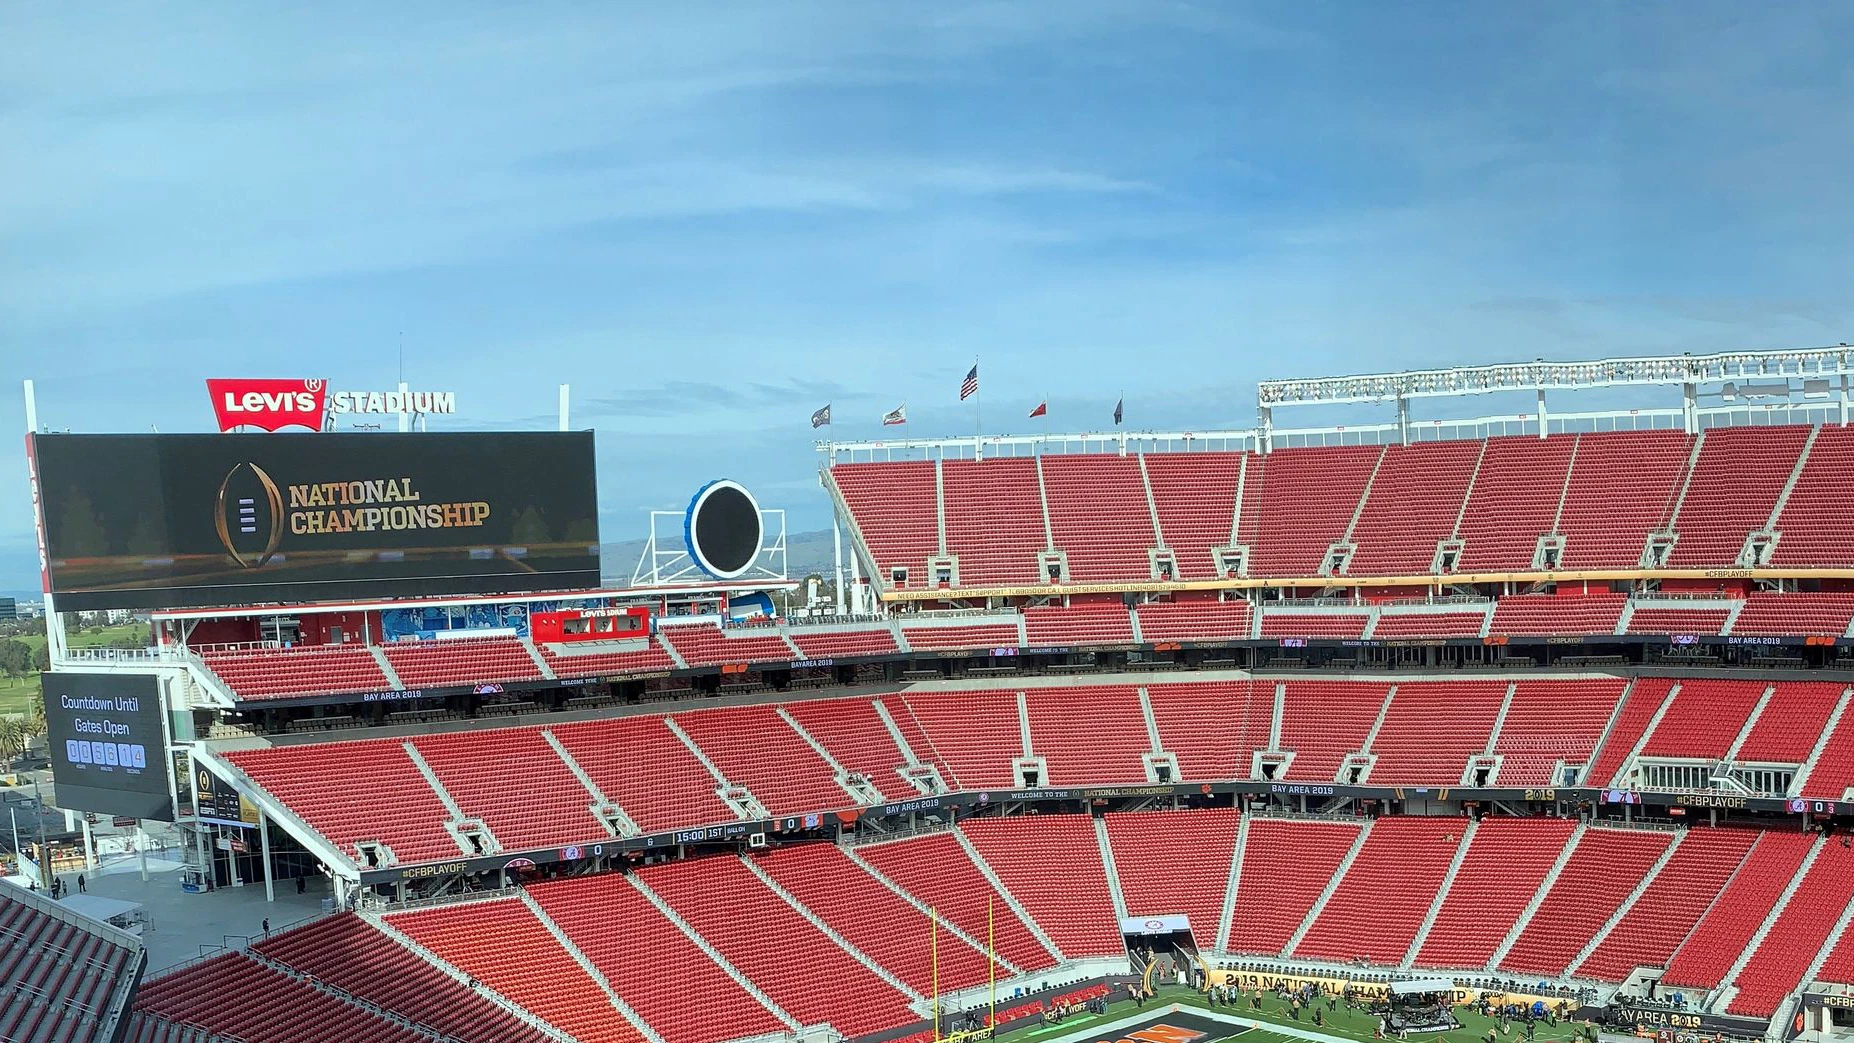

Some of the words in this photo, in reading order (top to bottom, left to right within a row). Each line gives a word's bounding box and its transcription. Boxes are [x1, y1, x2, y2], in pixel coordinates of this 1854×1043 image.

[332, 391, 456, 414] STADIUM
[288, 477, 420, 508] NATIONAL
[289, 501, 491, 535] CHAMPIONSHIP
[1704, 570, 1753, 578] #CFBPLAYOFF
[1728, 637, 1742, 645] BAY
[1743, 637, 1762, 645] AREA
[1762, 637, 1780, 645] 2019
[61, 694, 114, 710] Countdown
[114, 696, 139, 711] Until
[364, 692, 378, 702] BAY
[380, 692, 400, 700] AREA
[402, 691, 421, 699] 2019
[75, 718, 102, 733] Gates
[103, 719, 130, 738] Open
[1011, 791, 1043, 799] WELCOME
[1084, 788, 1120, 797] NATIONAL
[1122, 786, 1175, 795] CHAMPIONSHIP
[1272, 784, 1288, 793] BAY
[1288, 785, 1310, 795] AREA
[1312, 786, 1334, 796] 2019
[1525, 790, 1556, 801] 2019
[886, 804, 900, 814] BAY
[901, 802, 920, 812] AREA
[921, 800, 939, 810] 2019
[1676, 795, 1747, 809] #CFBPLAYOFF
[1815, 802, 1823, 812] 0
[788, 819, 795, 829] 0
[677, 830, 704, 843] 15:00
[708, 827, 722, 838] 1ST
[595, 845, 602, 855] 0
[402, 862, 468, 879] #CFBPLAYOFF
[1636, 1010, 1669, 1025] AREA
[1670, 1014, 1702, 1028] 2019
